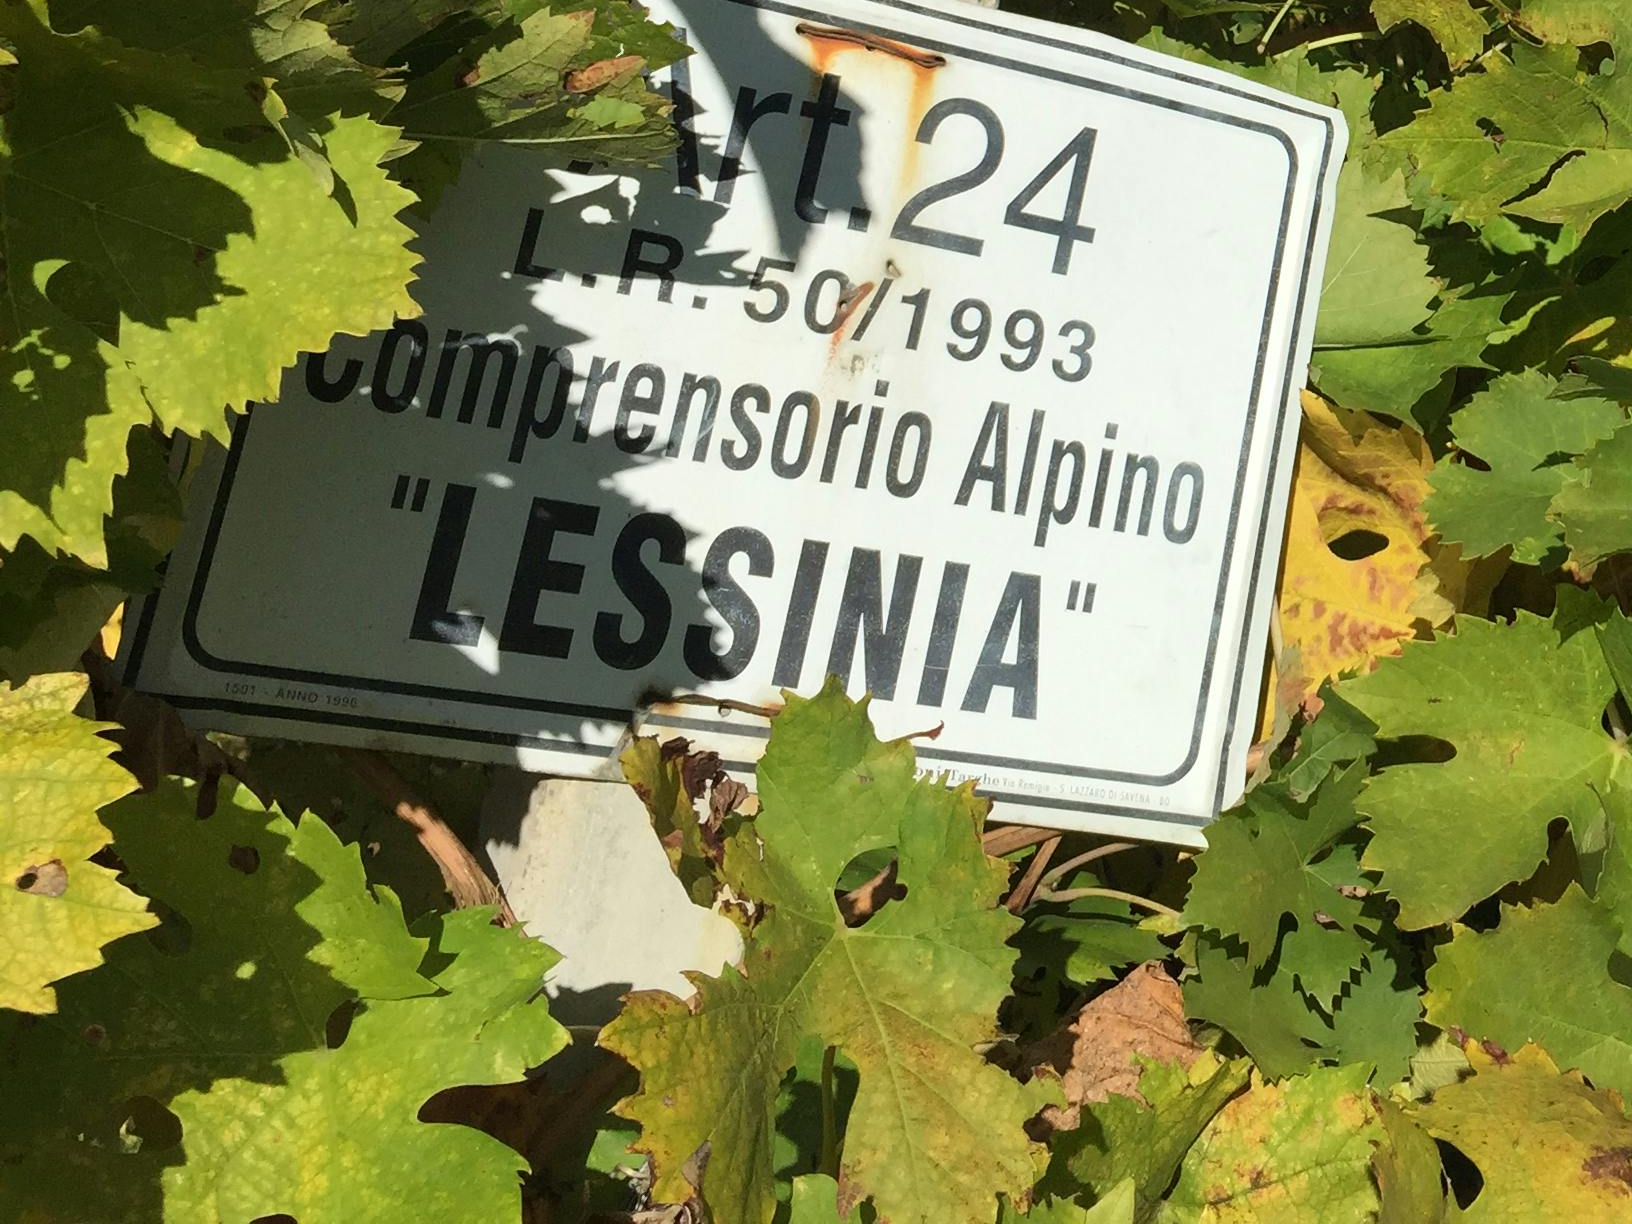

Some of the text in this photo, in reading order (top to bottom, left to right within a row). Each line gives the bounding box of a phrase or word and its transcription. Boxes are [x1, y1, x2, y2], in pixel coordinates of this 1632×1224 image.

[743, 257, 1097, 383] 50/1993
[953, 400, 1205, 548] Alpino
[390, 474, 1098, 721] "LESSINIA"
[275, 687, 318, 704] ANNO
